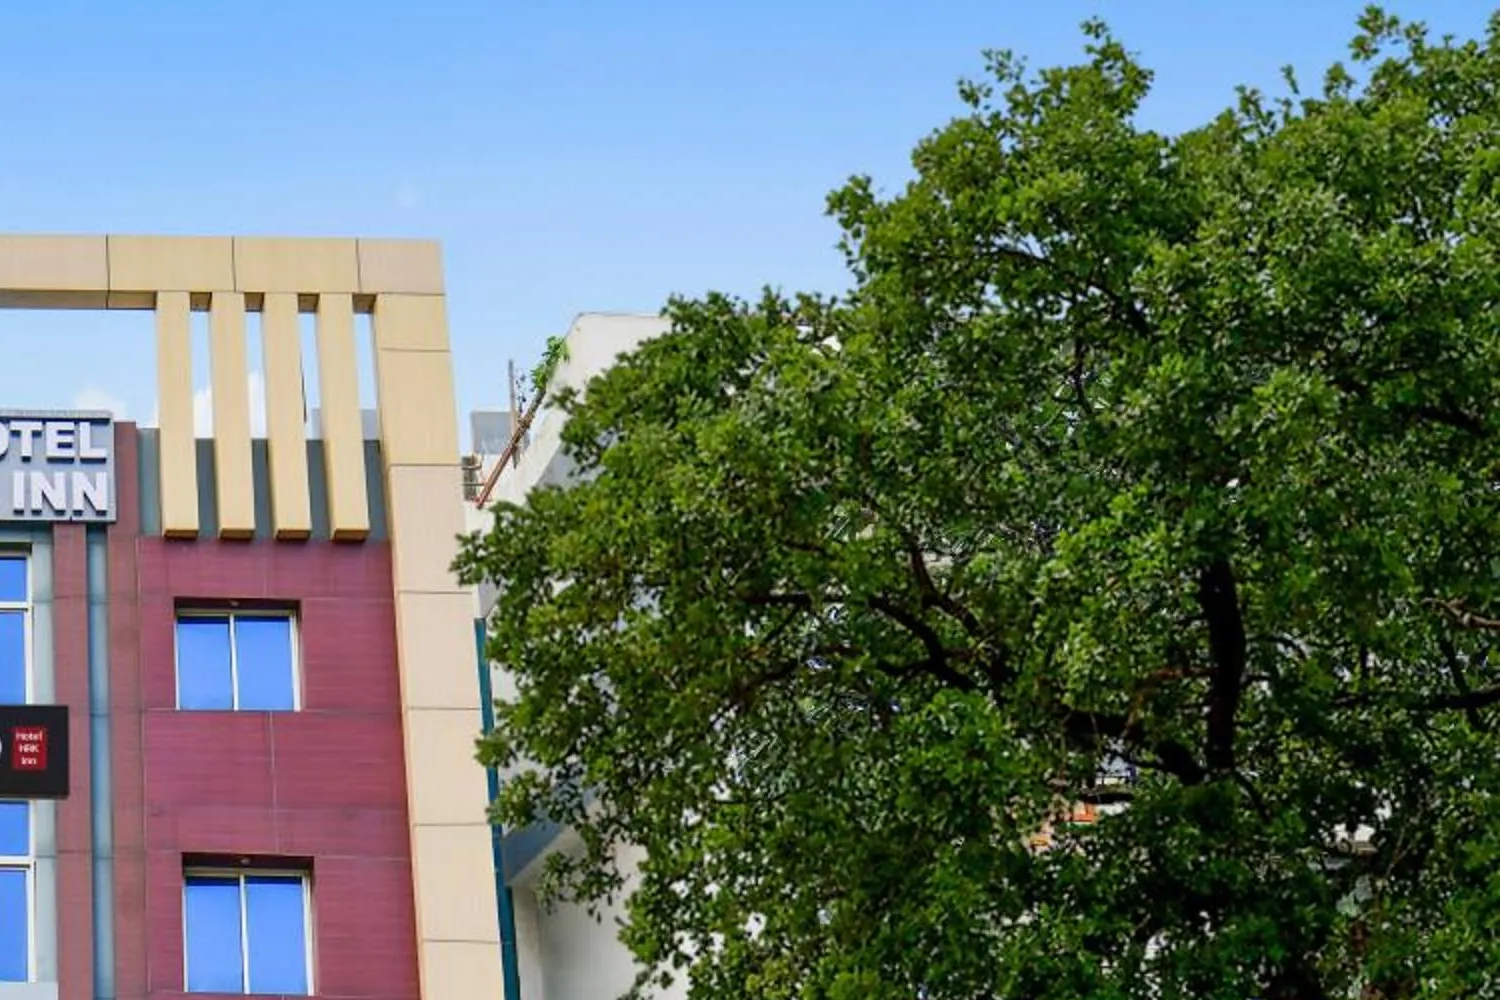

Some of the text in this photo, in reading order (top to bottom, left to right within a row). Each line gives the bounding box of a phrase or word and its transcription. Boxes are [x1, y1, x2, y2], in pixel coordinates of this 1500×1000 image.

[13, 471, 108, 514] INN
[15, 730, 43, 741] Hotel
[18, 743, 40, 753] HRK
